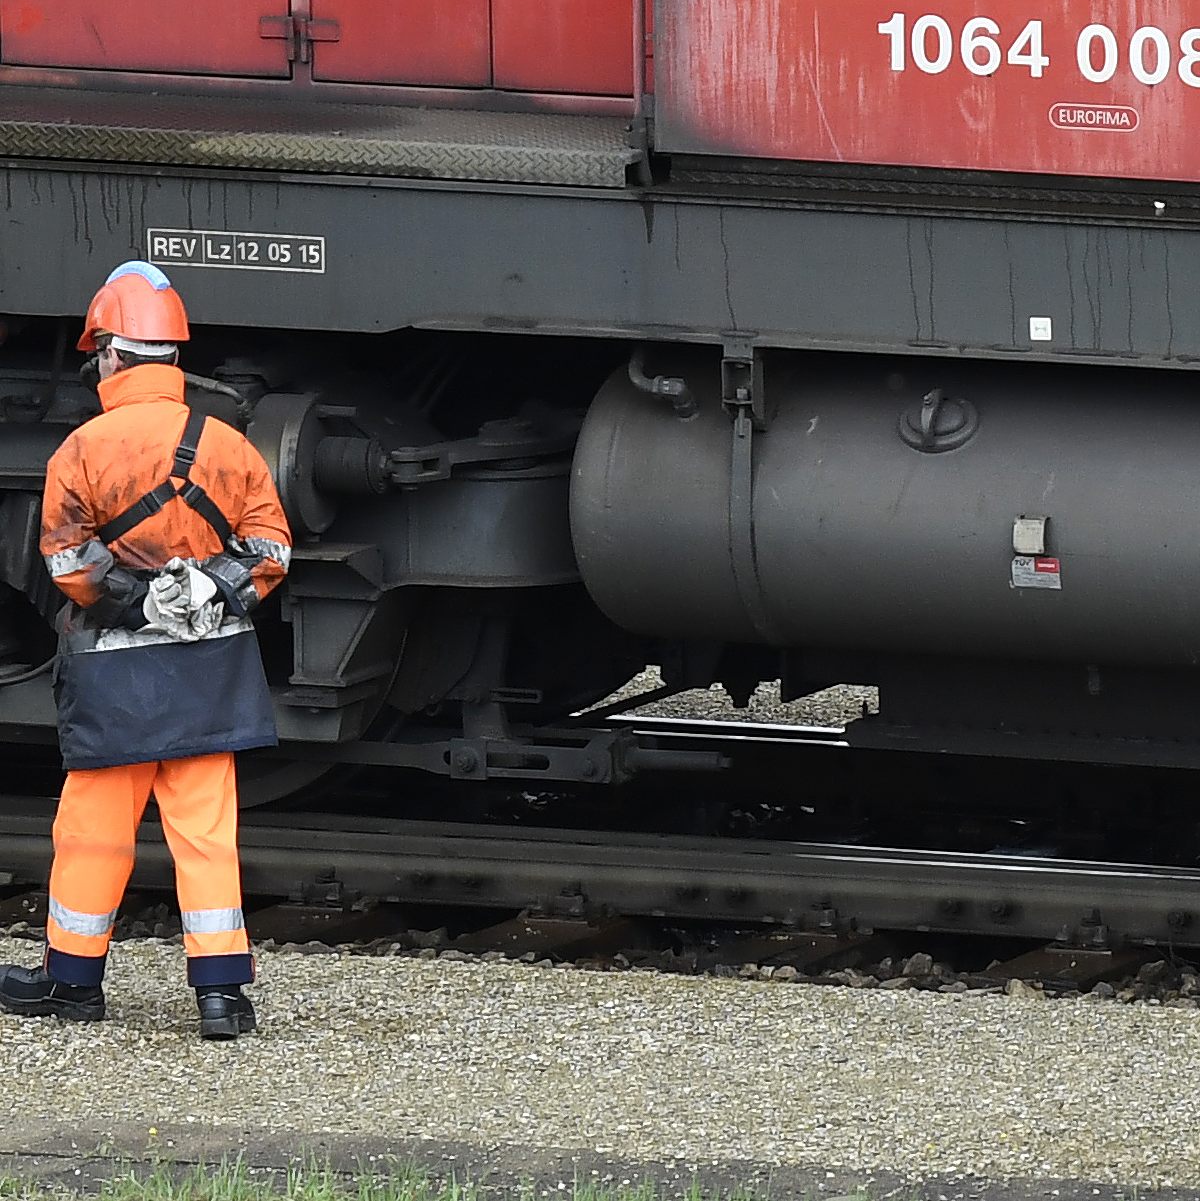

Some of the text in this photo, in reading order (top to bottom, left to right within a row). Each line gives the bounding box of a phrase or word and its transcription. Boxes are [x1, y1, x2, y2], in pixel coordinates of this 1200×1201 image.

[877, 12, 1049, 77] 1064
[1059, 108, 1131, 126] EUROFIMA
[153, 237, 320, 264] REV Lz 12 05 15
